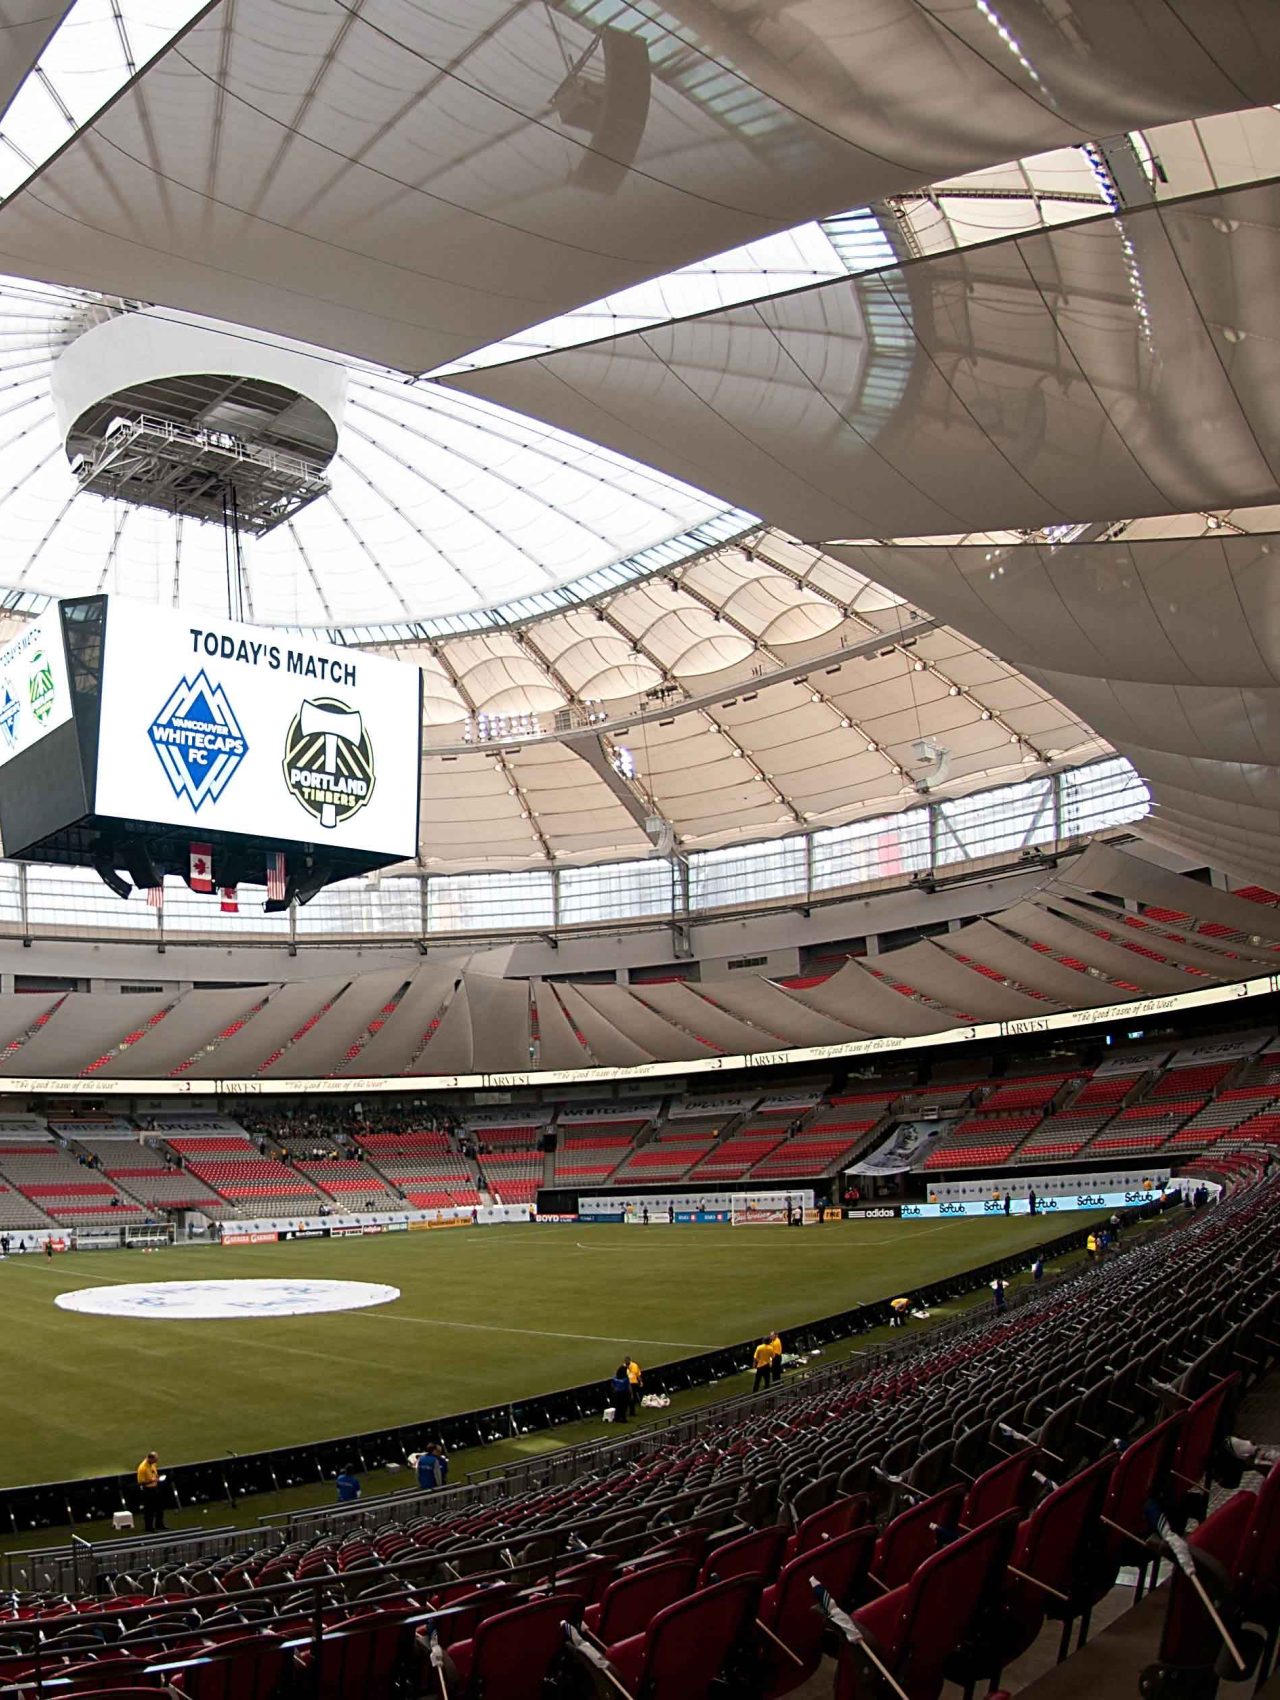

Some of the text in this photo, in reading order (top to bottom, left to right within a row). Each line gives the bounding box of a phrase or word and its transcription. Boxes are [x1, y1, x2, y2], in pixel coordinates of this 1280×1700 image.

[190, 628, 357, 687] TODAY'S MATCH
[171, 717, 229, 736] VANCOUVER
[152, 725, 244, 755] WHITECAPS
[188, 748, 208, 766] FC
[290, 768, 368, 797] PORTLAND
[302, 787, 356, 807] TIMBERS
[1000, 1019, 1050, 1036] HARVEST
[535, 1214, 559, 1222] BOYD
[866, 1209, 894, 1218] adidas
[901, 1204, 920, 1214] oftub
